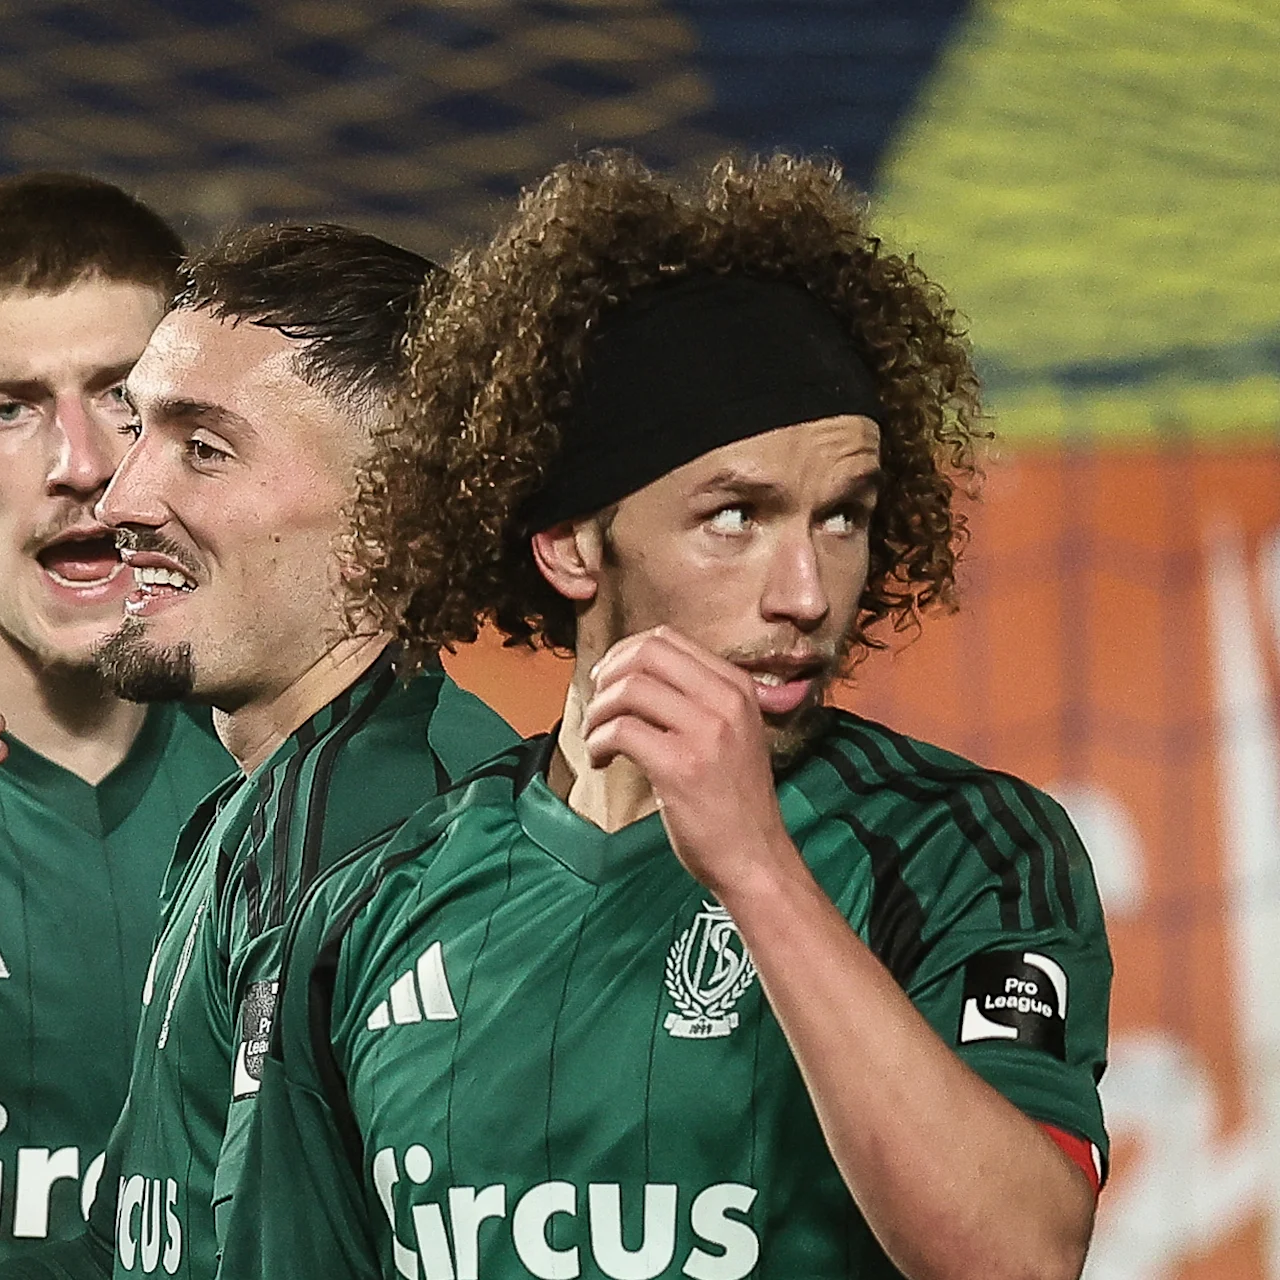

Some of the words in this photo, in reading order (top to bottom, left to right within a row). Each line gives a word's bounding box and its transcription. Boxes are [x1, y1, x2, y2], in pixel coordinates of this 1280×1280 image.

[1004, 977, 1038, 995] Pro
[984, 993, 1053, 1018] League
[258, 1017, 272, 1034] Pr
[246, 1040, 269, 1056] Lea
[114, 1174, 182, 1275] cus
